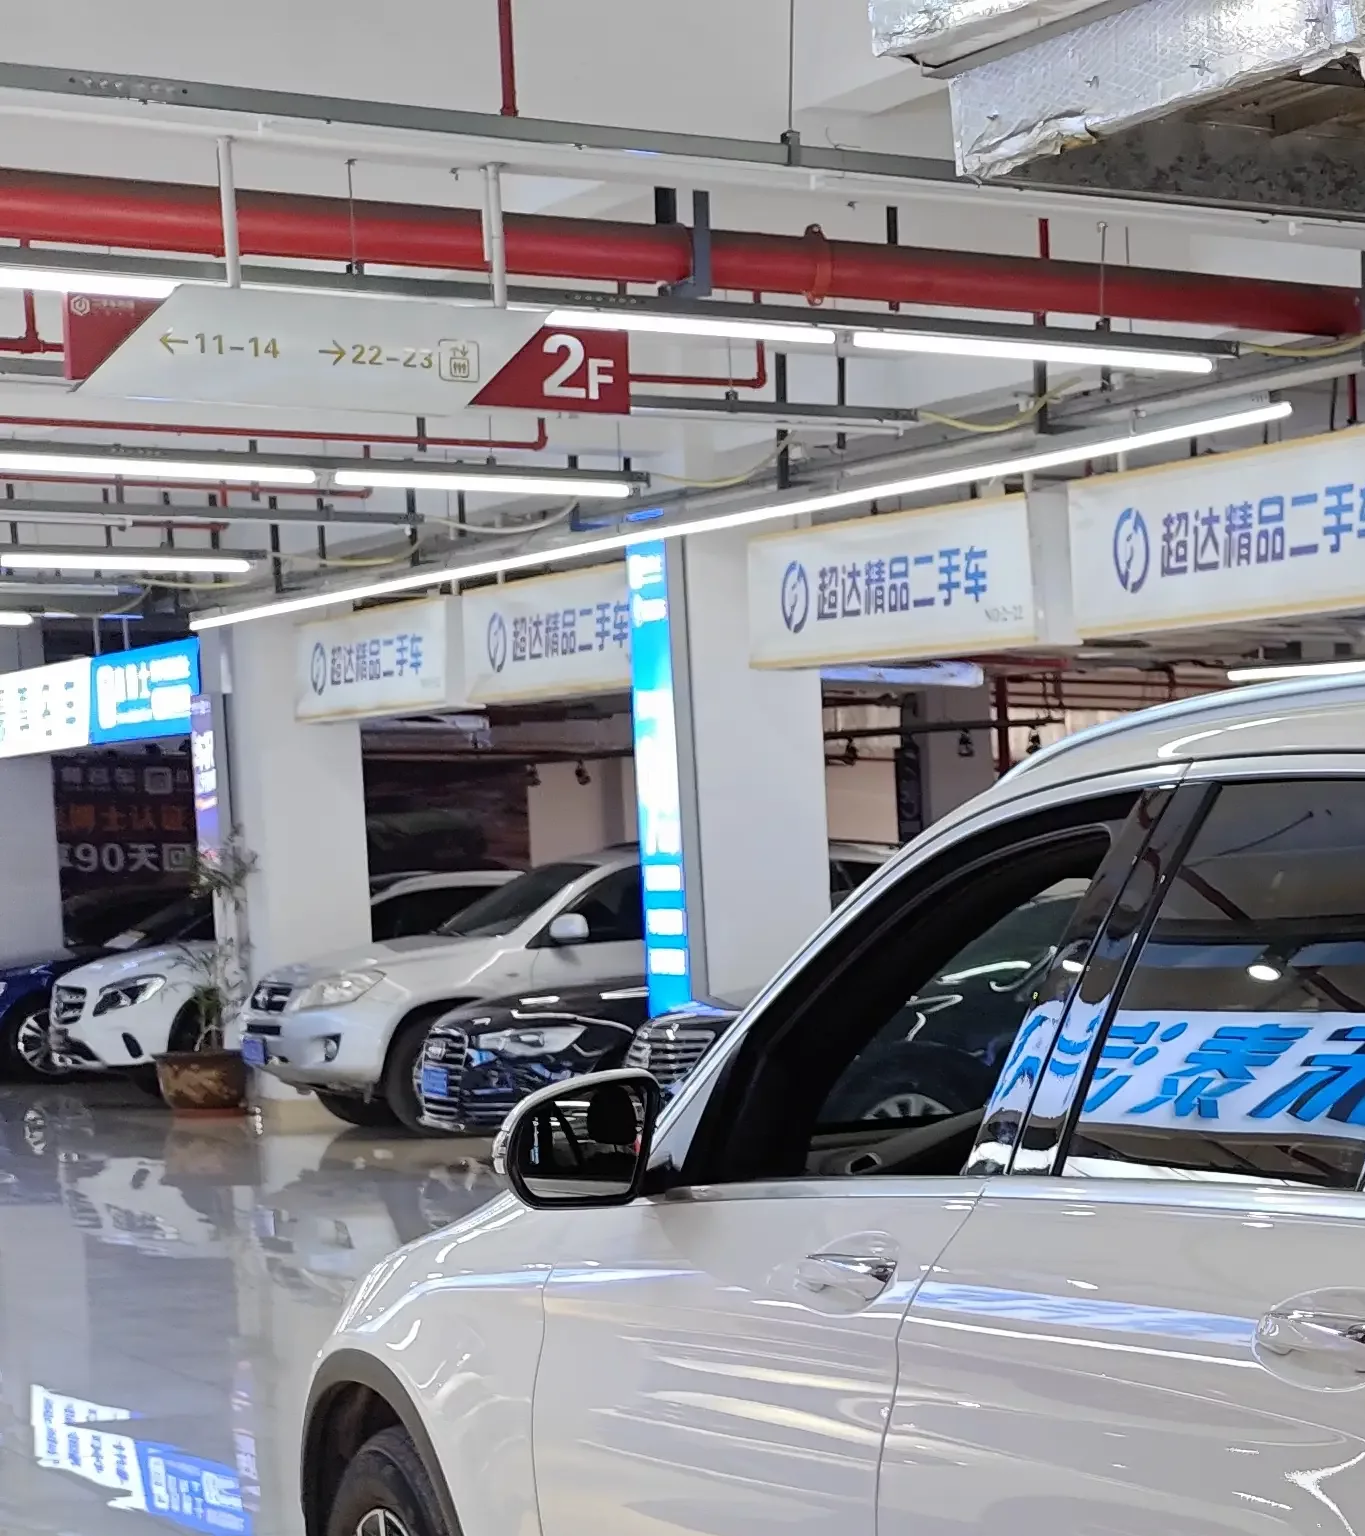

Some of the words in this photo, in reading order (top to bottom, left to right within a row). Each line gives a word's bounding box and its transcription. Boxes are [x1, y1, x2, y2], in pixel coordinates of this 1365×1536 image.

[195, 333, 280, 358] 11-14
[352, 344, 433, 369] 22-23
[542, 334, 614, 400] 2F
[817, 546, 988, 620] 超达精品二手车
[330, 633, 423, 686] 超达精品二手车
[512, 600, 630, 662] 超达精品二手车
